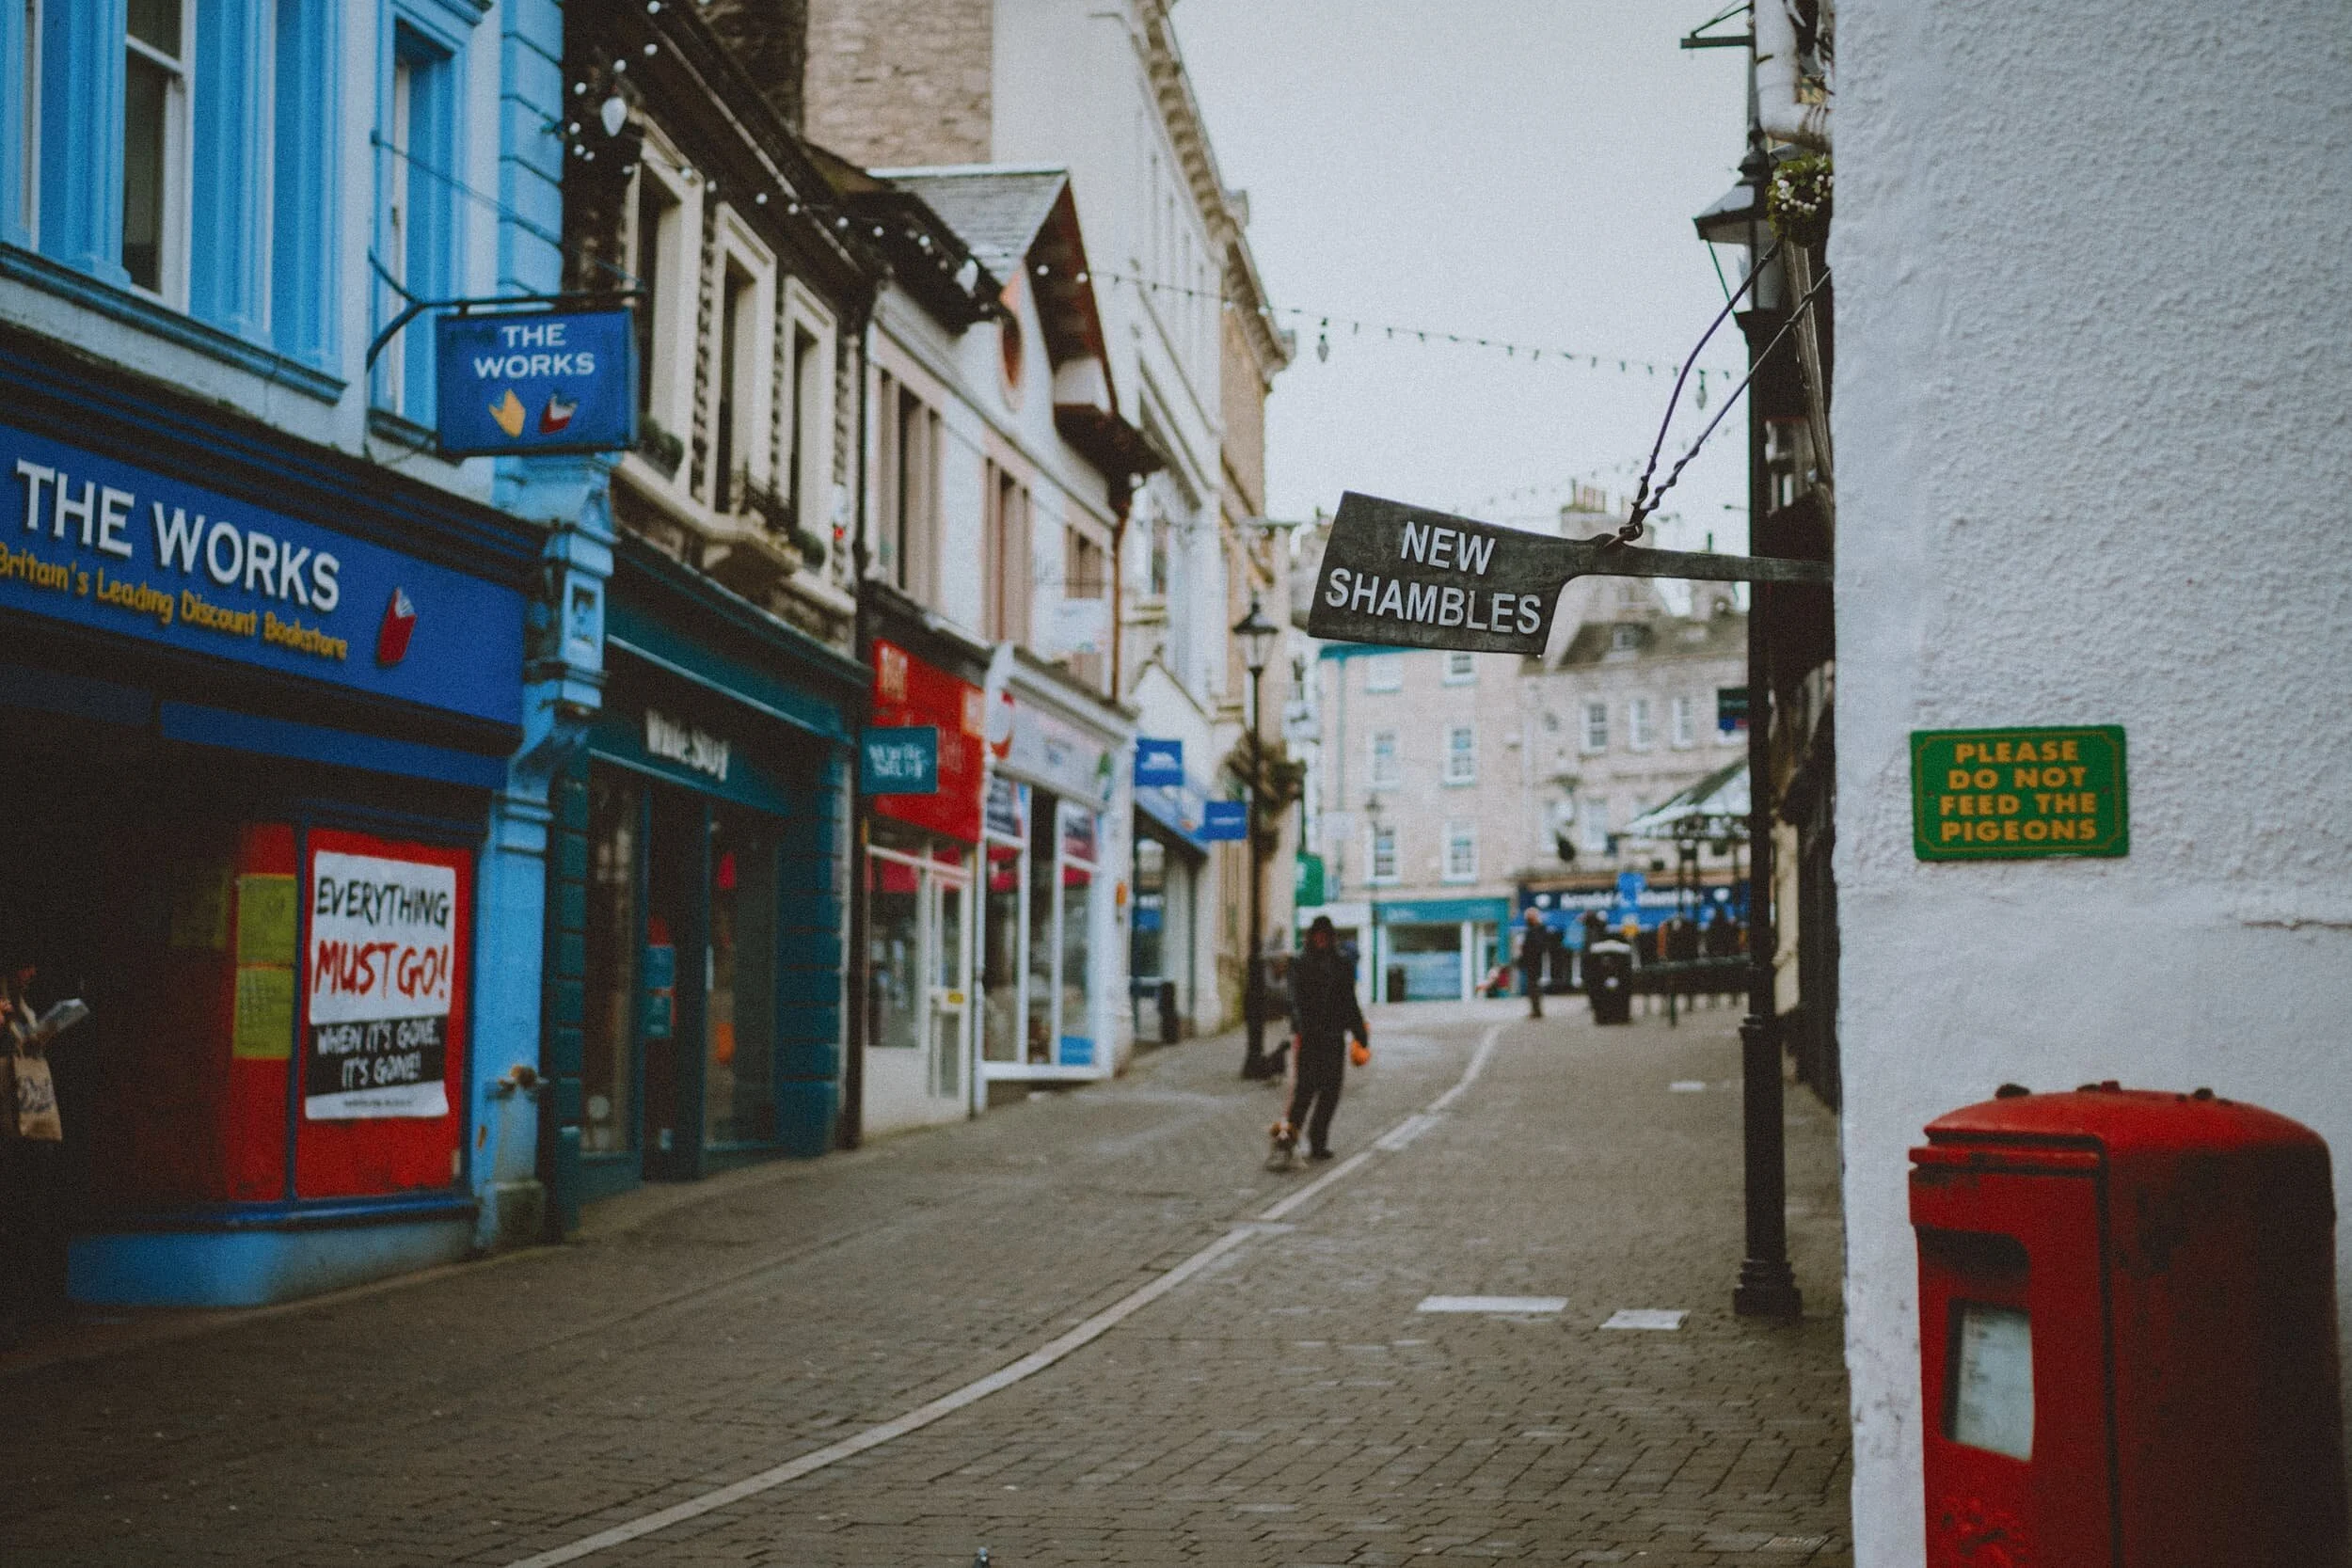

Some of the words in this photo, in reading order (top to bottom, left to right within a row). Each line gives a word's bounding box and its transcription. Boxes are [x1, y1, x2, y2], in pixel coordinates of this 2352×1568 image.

[501, 323, 566, 349] THE
[473, 351, 596, 379] WORKS
[17, 457, 135, 558] THE
[153, 500, 341, 611] WORKS
[1400, 520, 1496, 576] NEW
[97, 567, 174, 625] Leading
[181, 590, 258, 637] Discount
[1324, 566, 1542, 635] SHAMBLES
[1954, 739, 2080, 764] PLEASE
[1947, 768, 1999, 790] DO
[2013, 767, 2088, 788] NOT
[1939, 794, 2022, 816] FEED
[2032, 792, 2098, 815] THE
[1941, 818, 2098, 843] PIGEONS
[316, 876, 451, 931] EVERYTHING
[314, 939, 399, 1000] MUST
[397, 943, 449, 1000] GO!
[317, 1024, 364, 1054] WHEN
[366, 1021, 392, 1053] IT'S
[341, 1056, 371, 1088] IT'S
